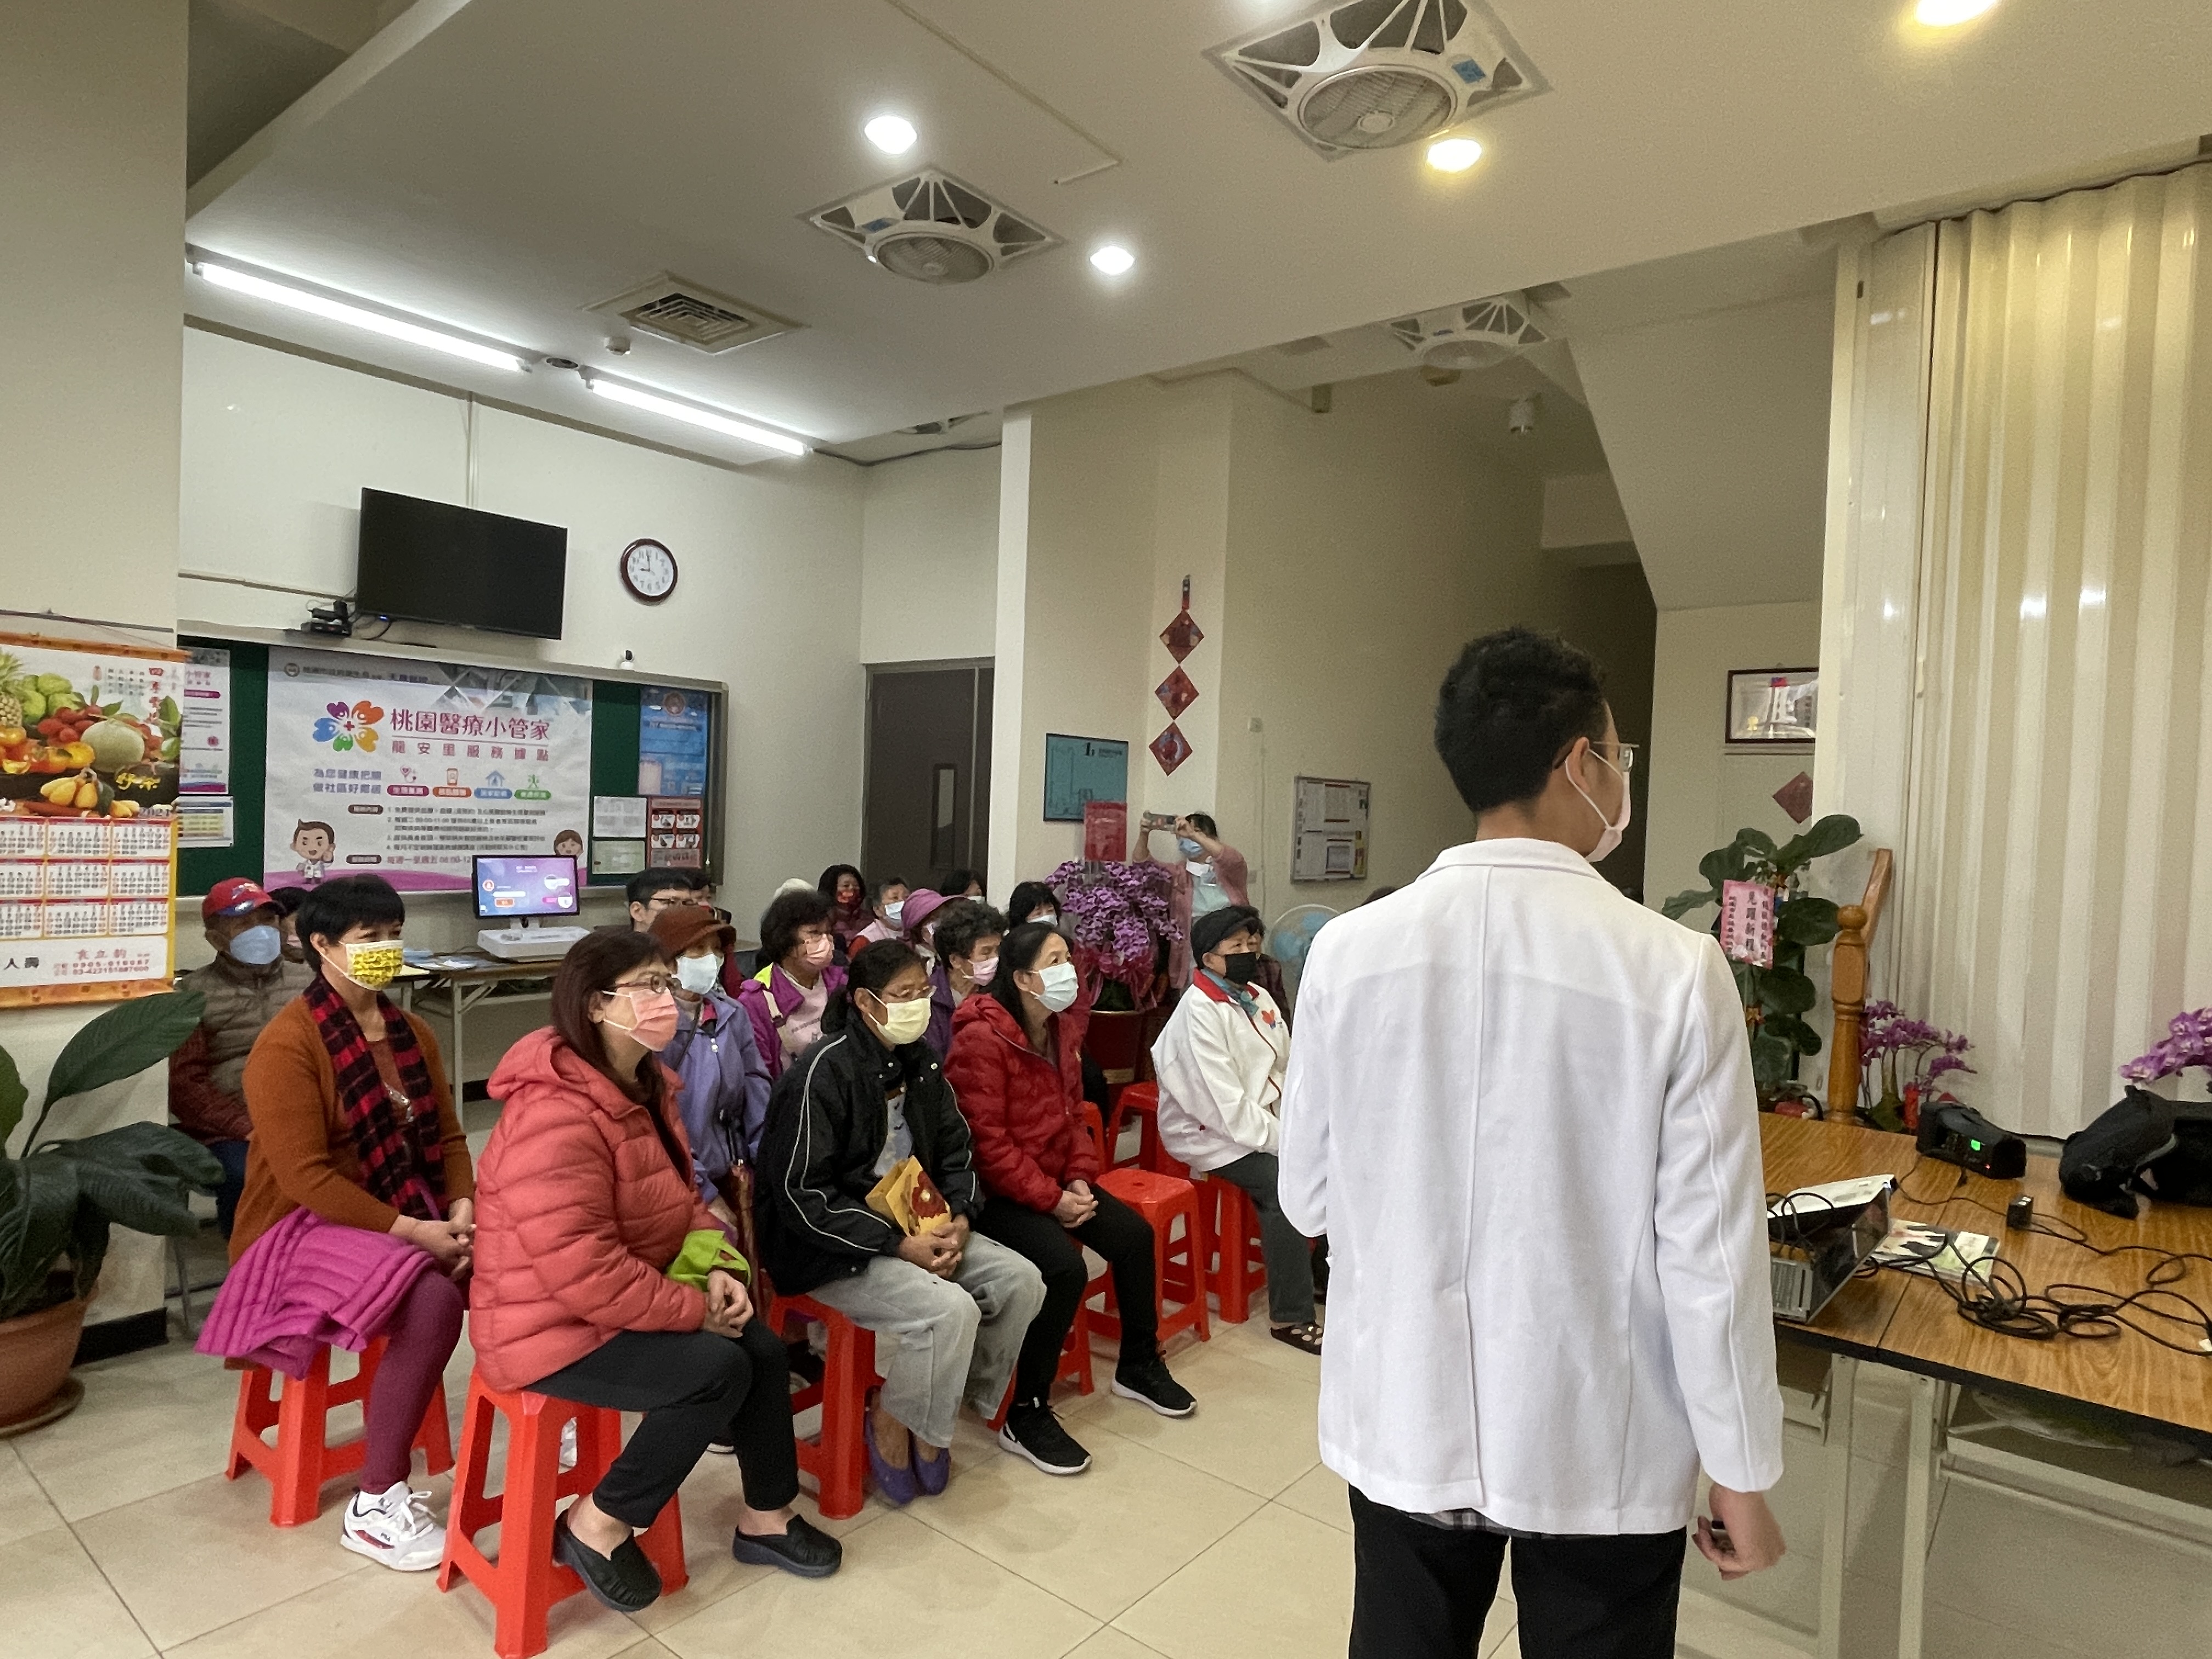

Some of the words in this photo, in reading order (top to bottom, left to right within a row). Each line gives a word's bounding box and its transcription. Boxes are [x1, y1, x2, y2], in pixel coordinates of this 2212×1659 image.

[390, 708, 550, 741] 桃園醫療小管家
